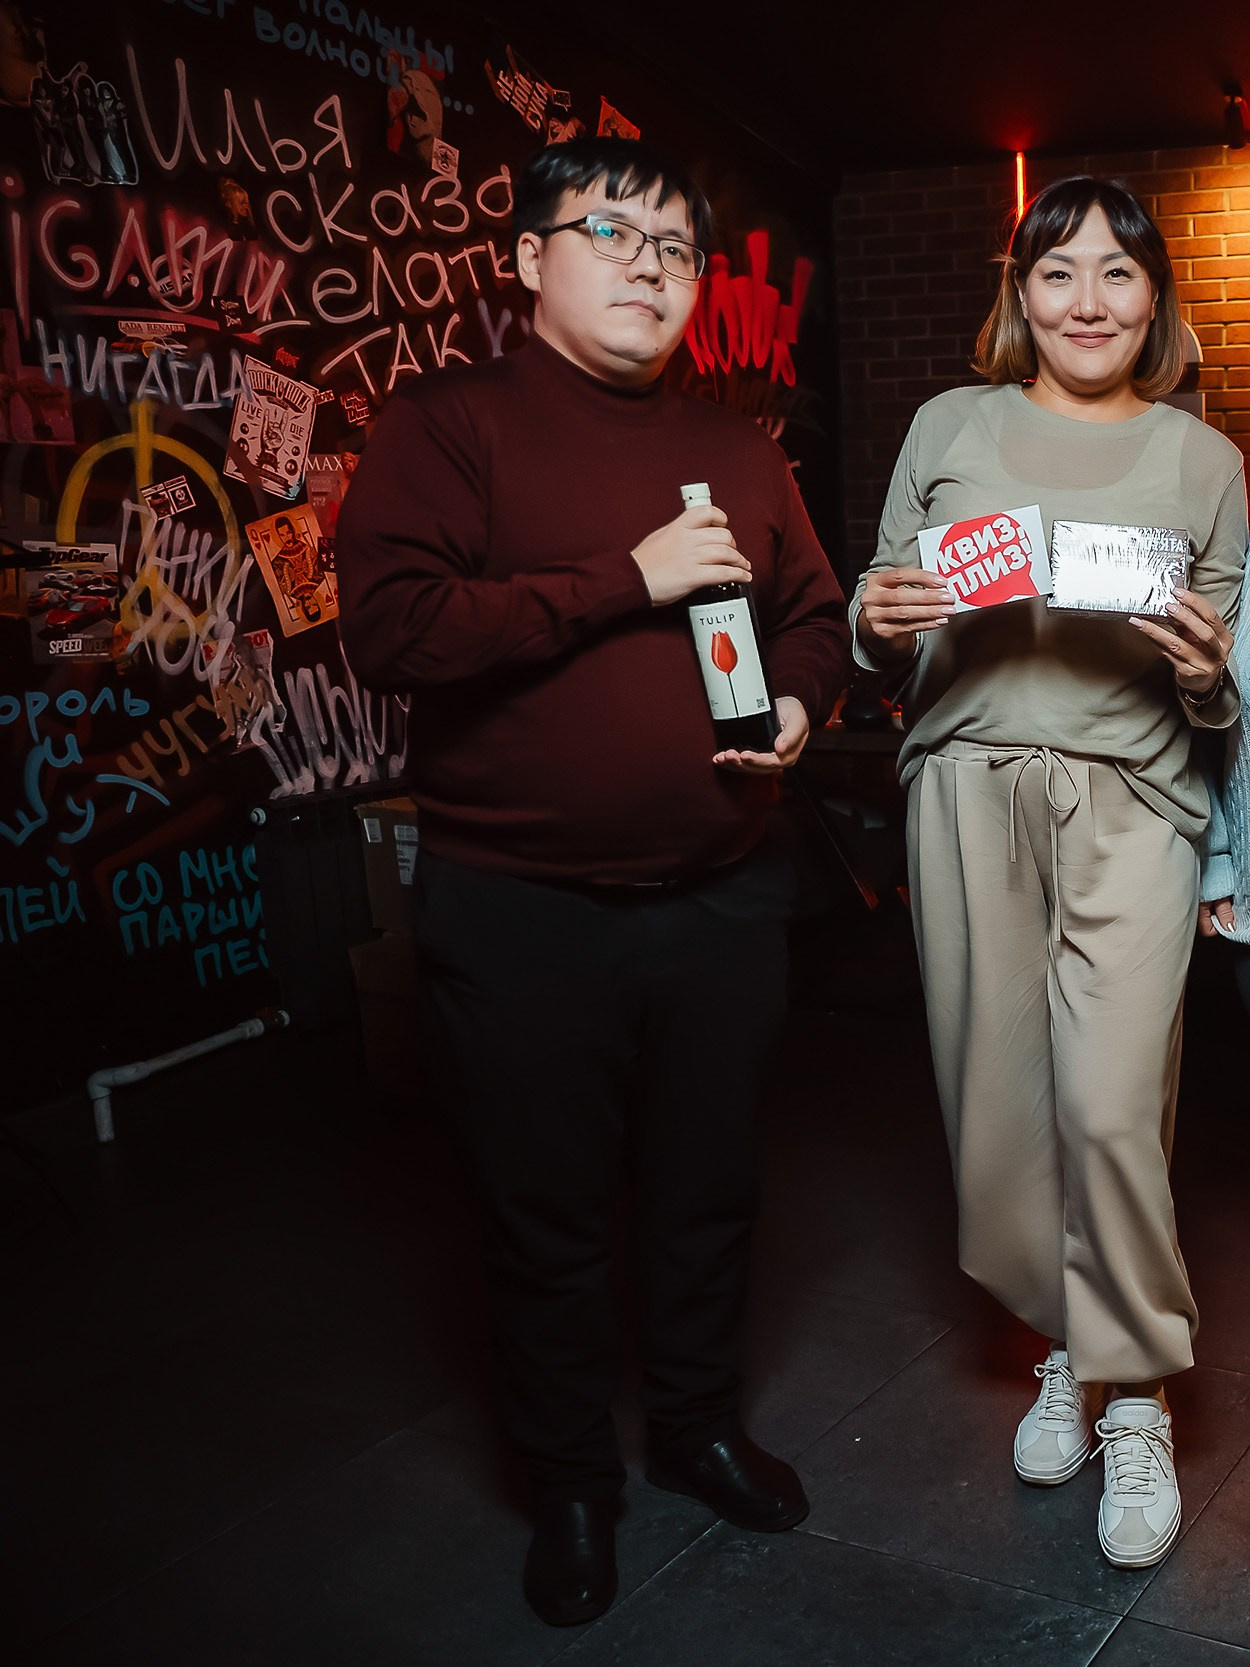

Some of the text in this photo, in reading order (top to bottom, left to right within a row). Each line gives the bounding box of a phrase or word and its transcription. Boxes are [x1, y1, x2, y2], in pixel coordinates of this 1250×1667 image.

[125, 43, 352, 175] Илья
[320, 312, 473, 396] ТАК
[241, 402, 263, 419] LIVE
[248, 370, 278, 392] ROCK
[284, 381, 311, 413] ROLL
[289, 423, 305, 438] DIE
[936, 516, 1027, 576] КВИЗ,
[947, 539, 1033, 601] ПЛИЗ!
[699, 613, 735, 626] TULIP
[49, 639, 82, 655] SPEED
[112, 862, 163, 911] СО
